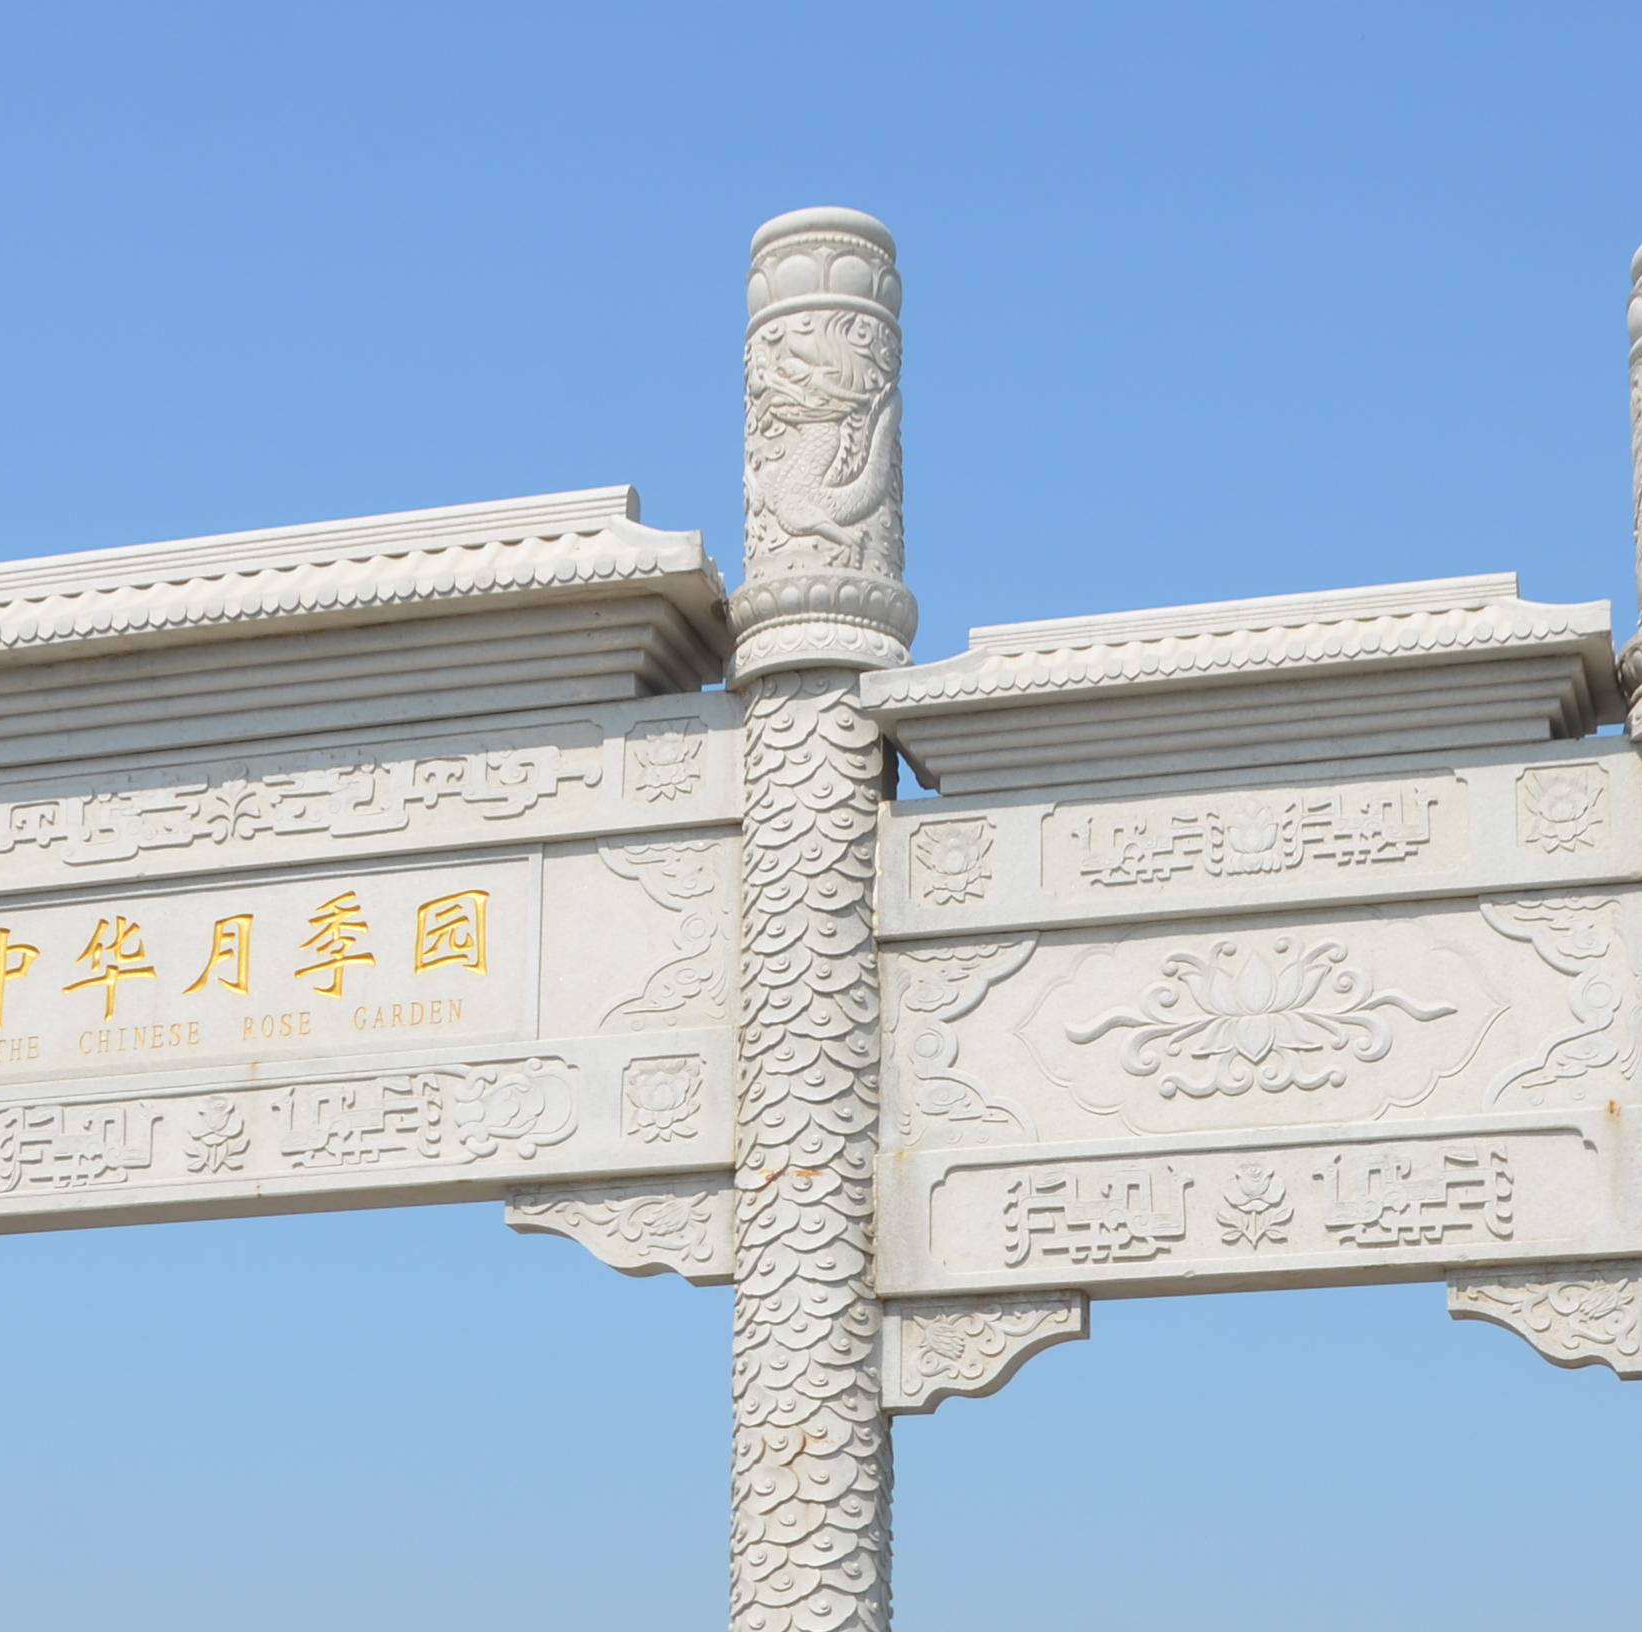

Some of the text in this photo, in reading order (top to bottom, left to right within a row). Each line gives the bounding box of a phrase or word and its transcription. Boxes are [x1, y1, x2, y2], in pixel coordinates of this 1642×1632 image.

[79, 1021, 201, 1054] CHINESE
[243, 1011, 311, 1040] ROSE
[353, 999, 463, 1031] GARDEN
